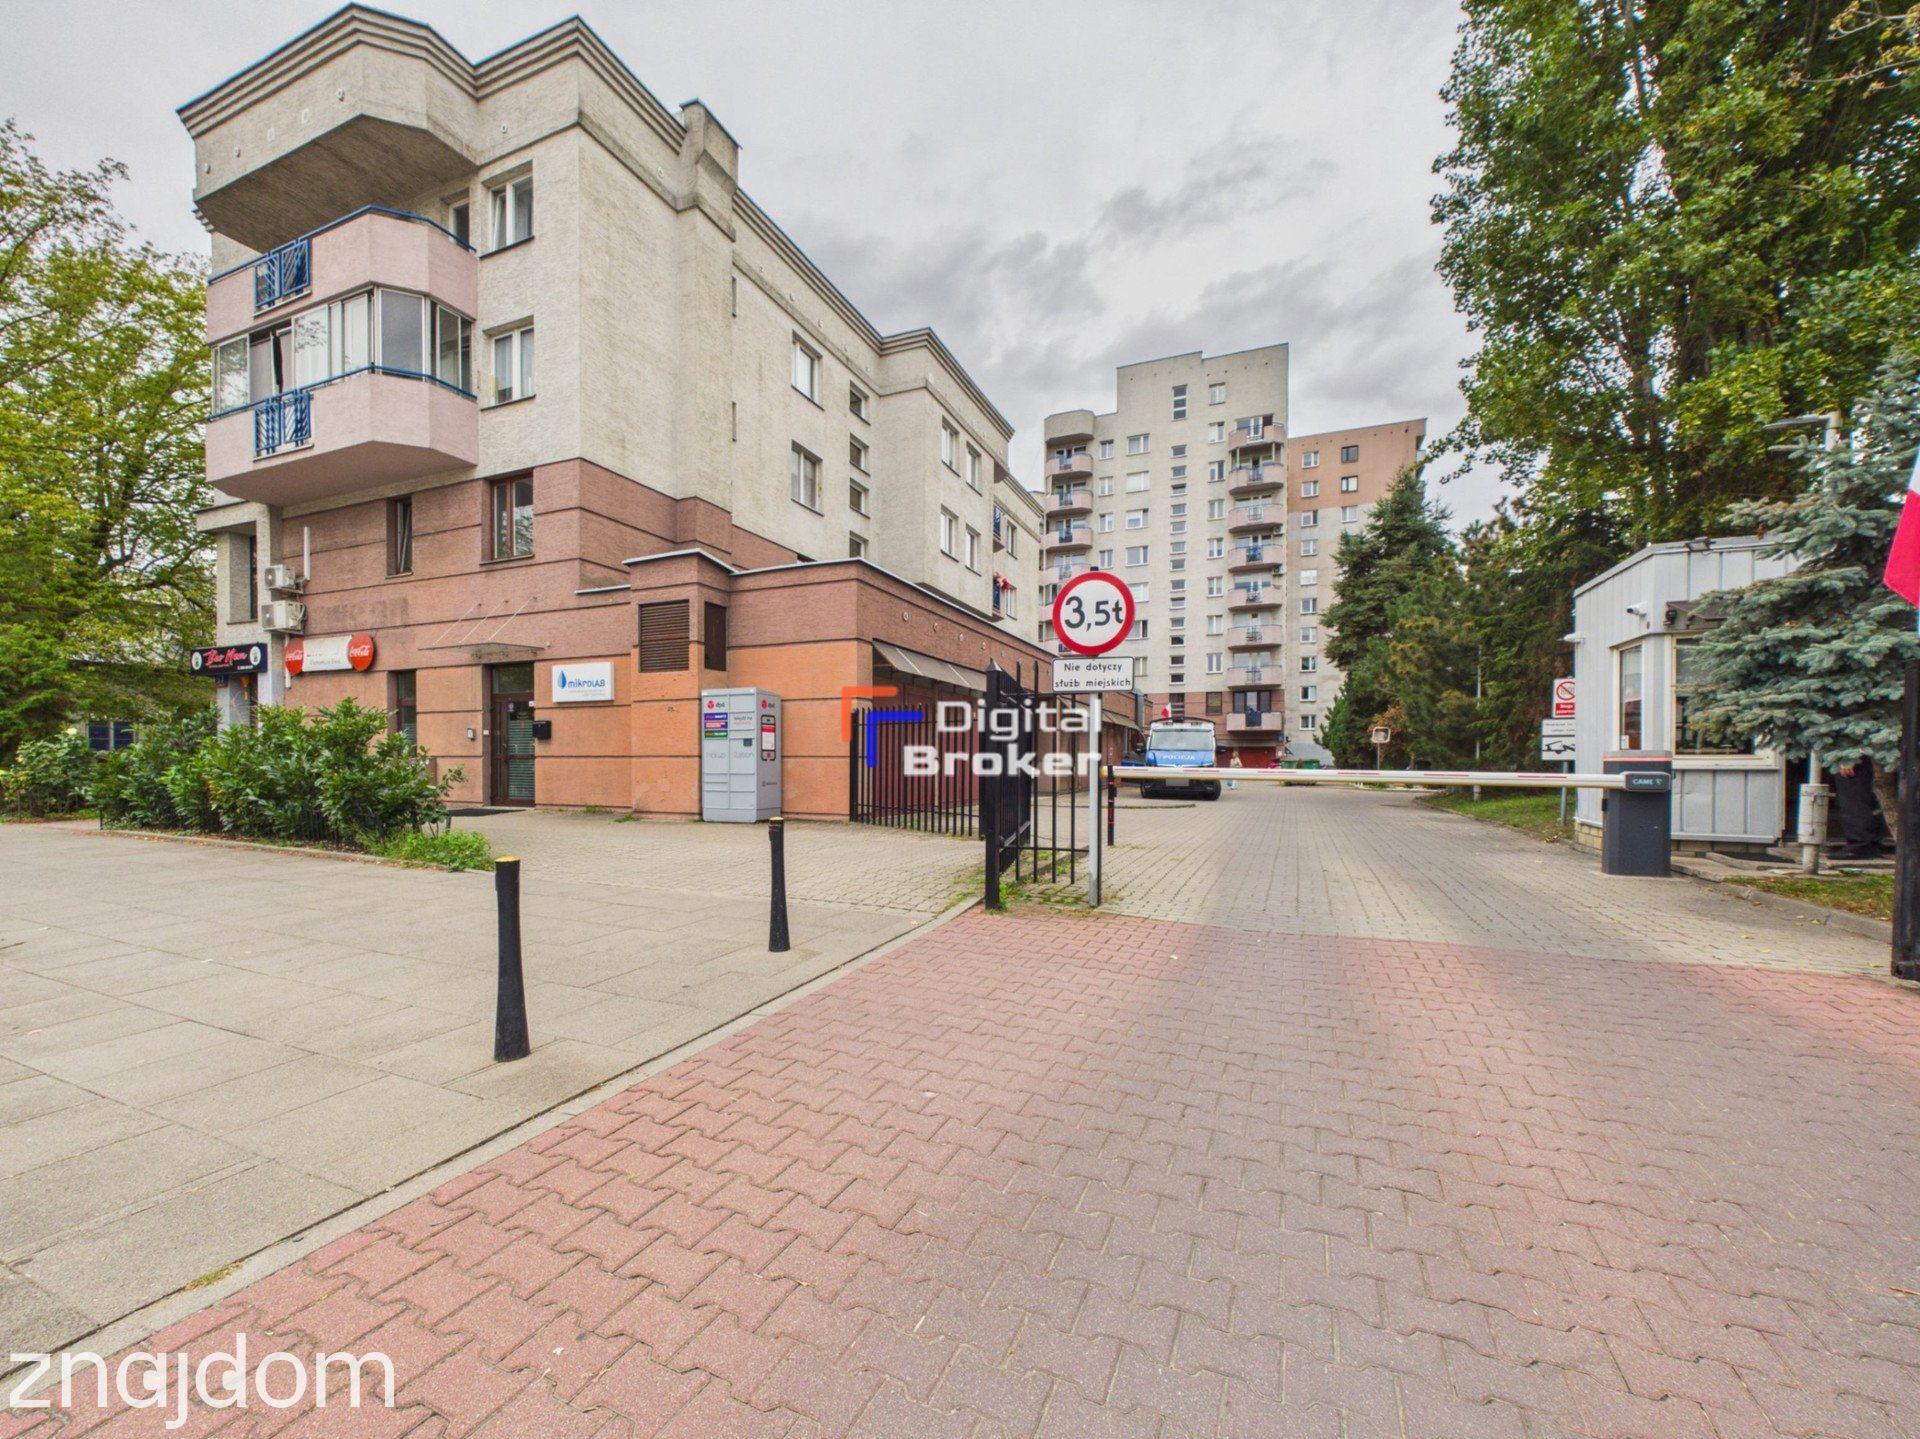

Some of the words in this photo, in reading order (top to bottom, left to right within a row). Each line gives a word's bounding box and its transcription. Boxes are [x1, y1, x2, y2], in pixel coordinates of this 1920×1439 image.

[1064, 595, 1124, 632] 3,5t
[1064, 663, 1080, 671] Nie
[1086, 663, 1122, 673] dotyczy
[1055, 679, 1080, 688] służb
[1085, 678, 1131, 688] miejskich
